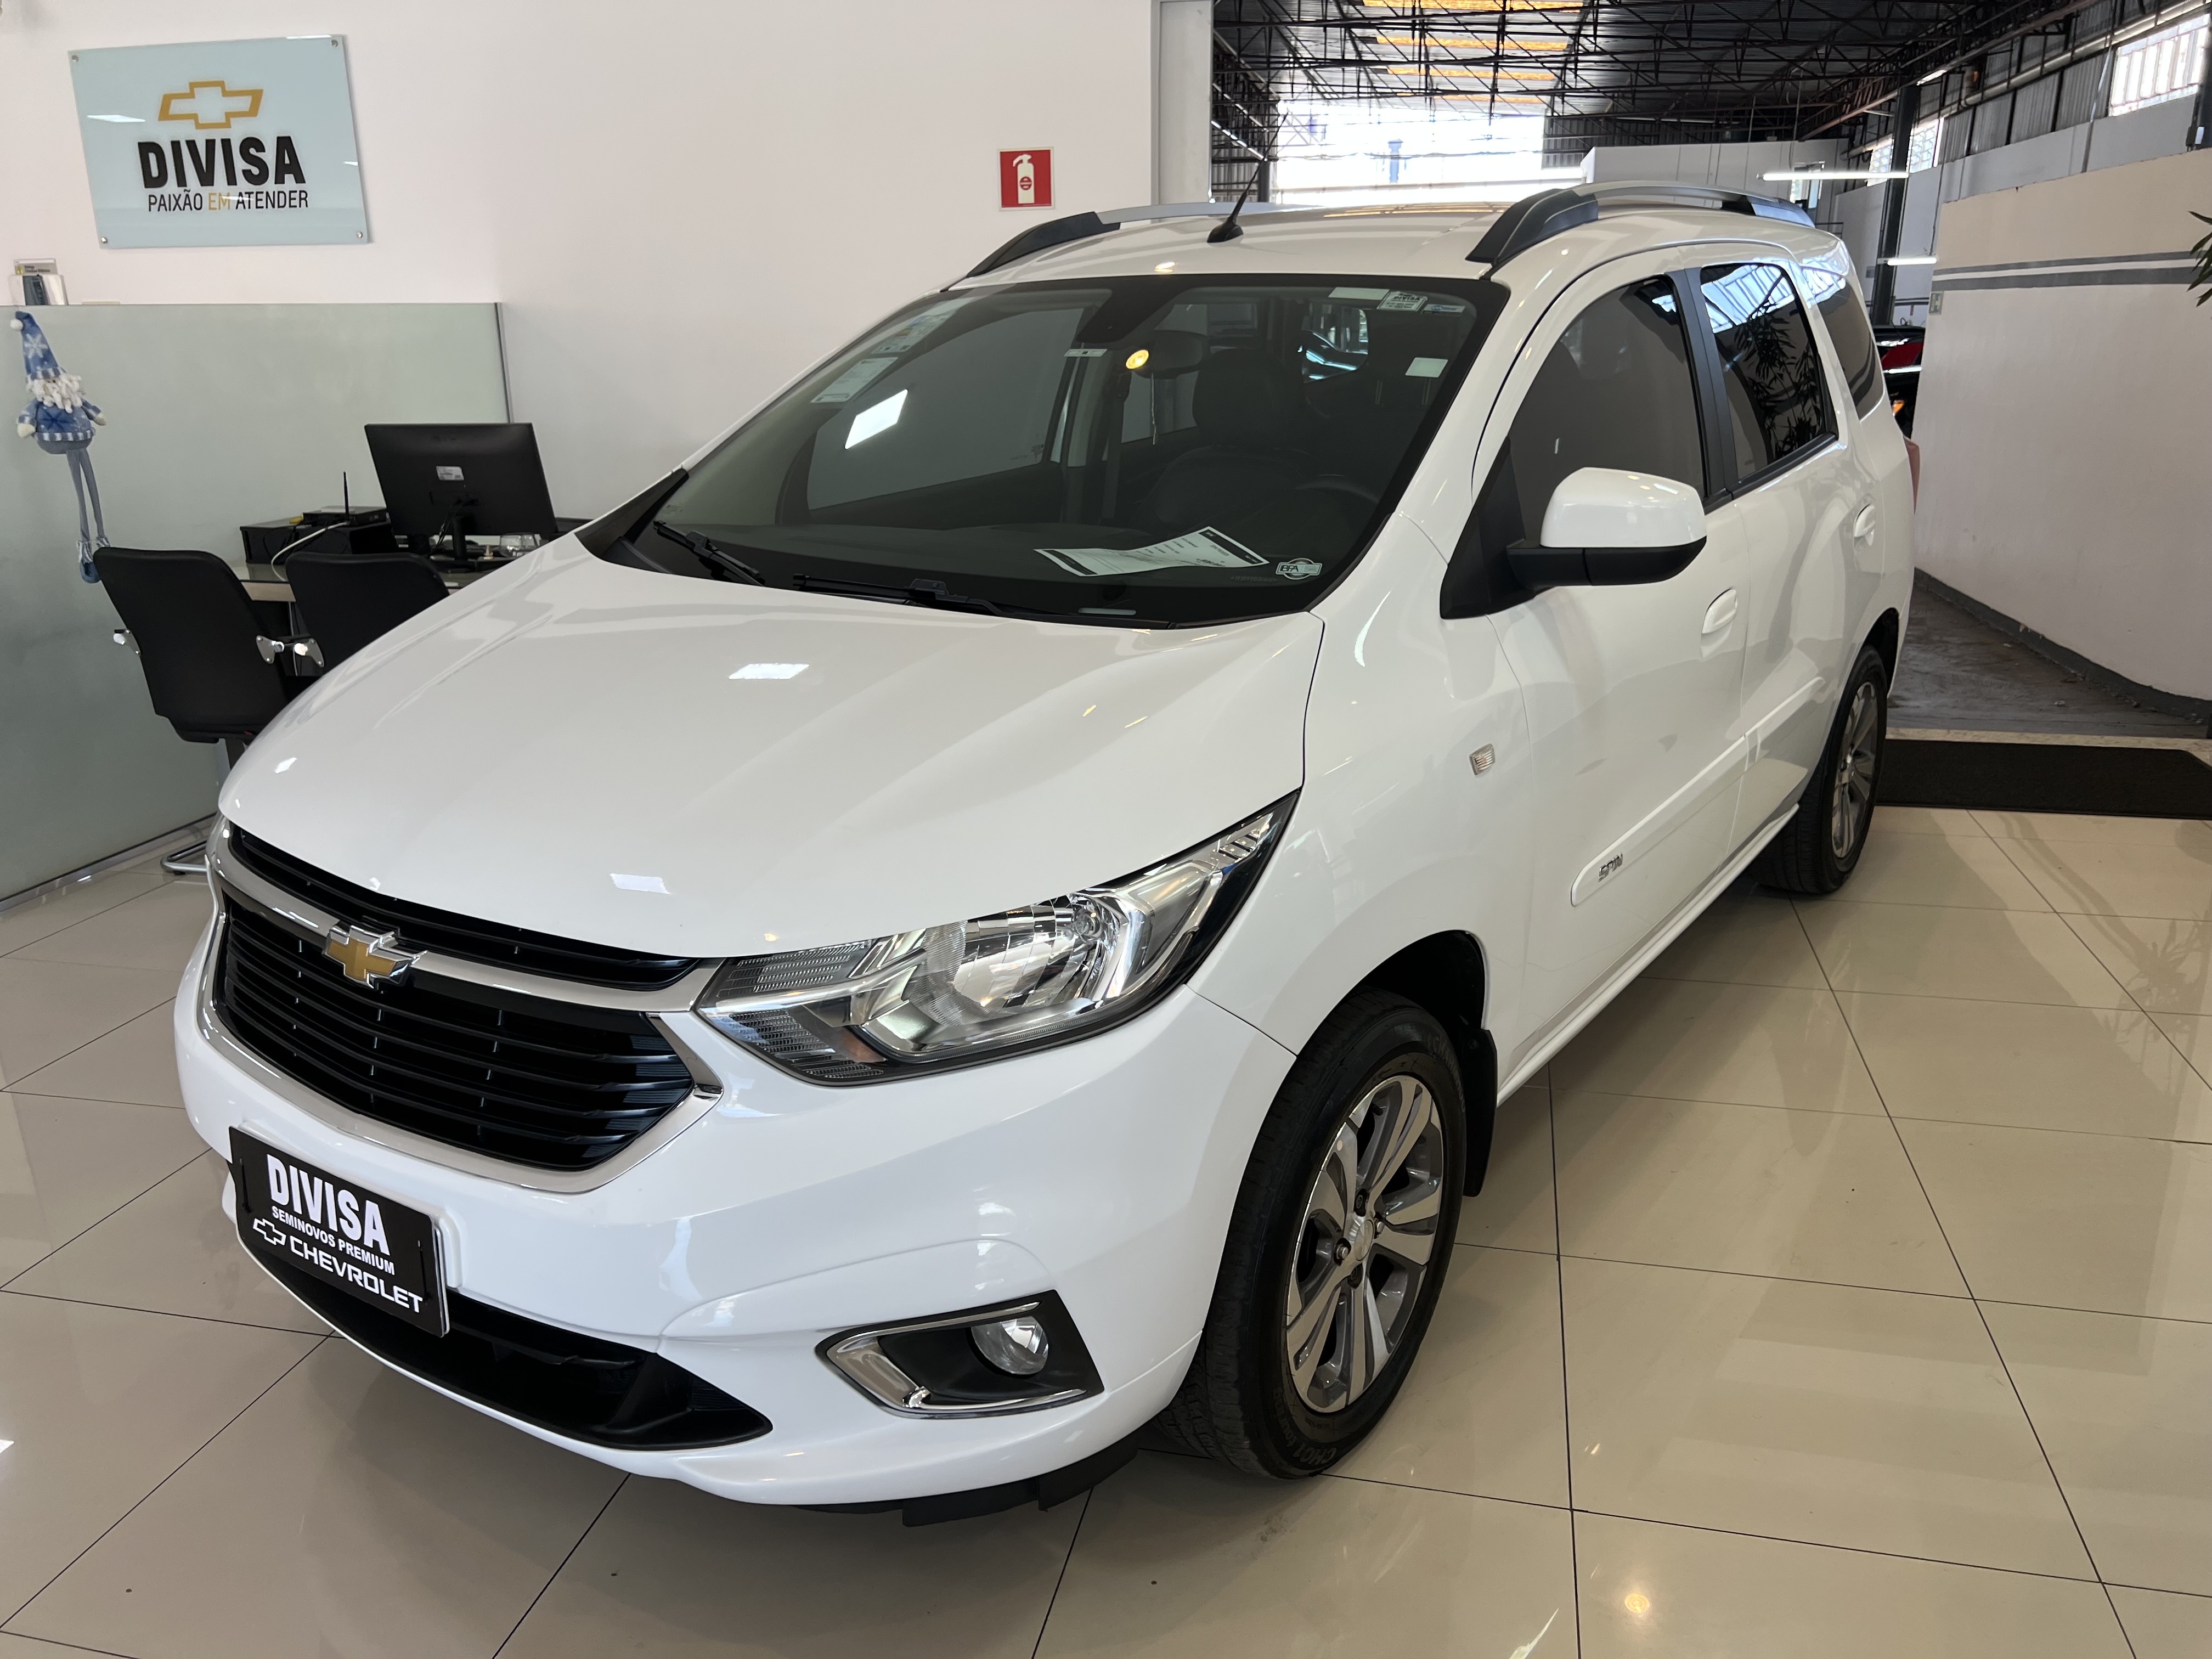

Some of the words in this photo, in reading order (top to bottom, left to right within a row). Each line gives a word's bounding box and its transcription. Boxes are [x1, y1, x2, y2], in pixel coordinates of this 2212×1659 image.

[137, 136, 306, 189] DIVISA
[148, 189, 203, 212] PAIXÃO
[208, 192, 231, 211] EM
[235, 190, 308, 210] ATENDER
[1598, 851, 1623, 883] SPIN
[267, 1154, 391, 1256] DIVISA
[272, 1205, 336, 1248] SEMINOVOS
[338, 1238, 396, 1276] PREMIUM
[290, 1235, 423, 1313] CHEVROLET
